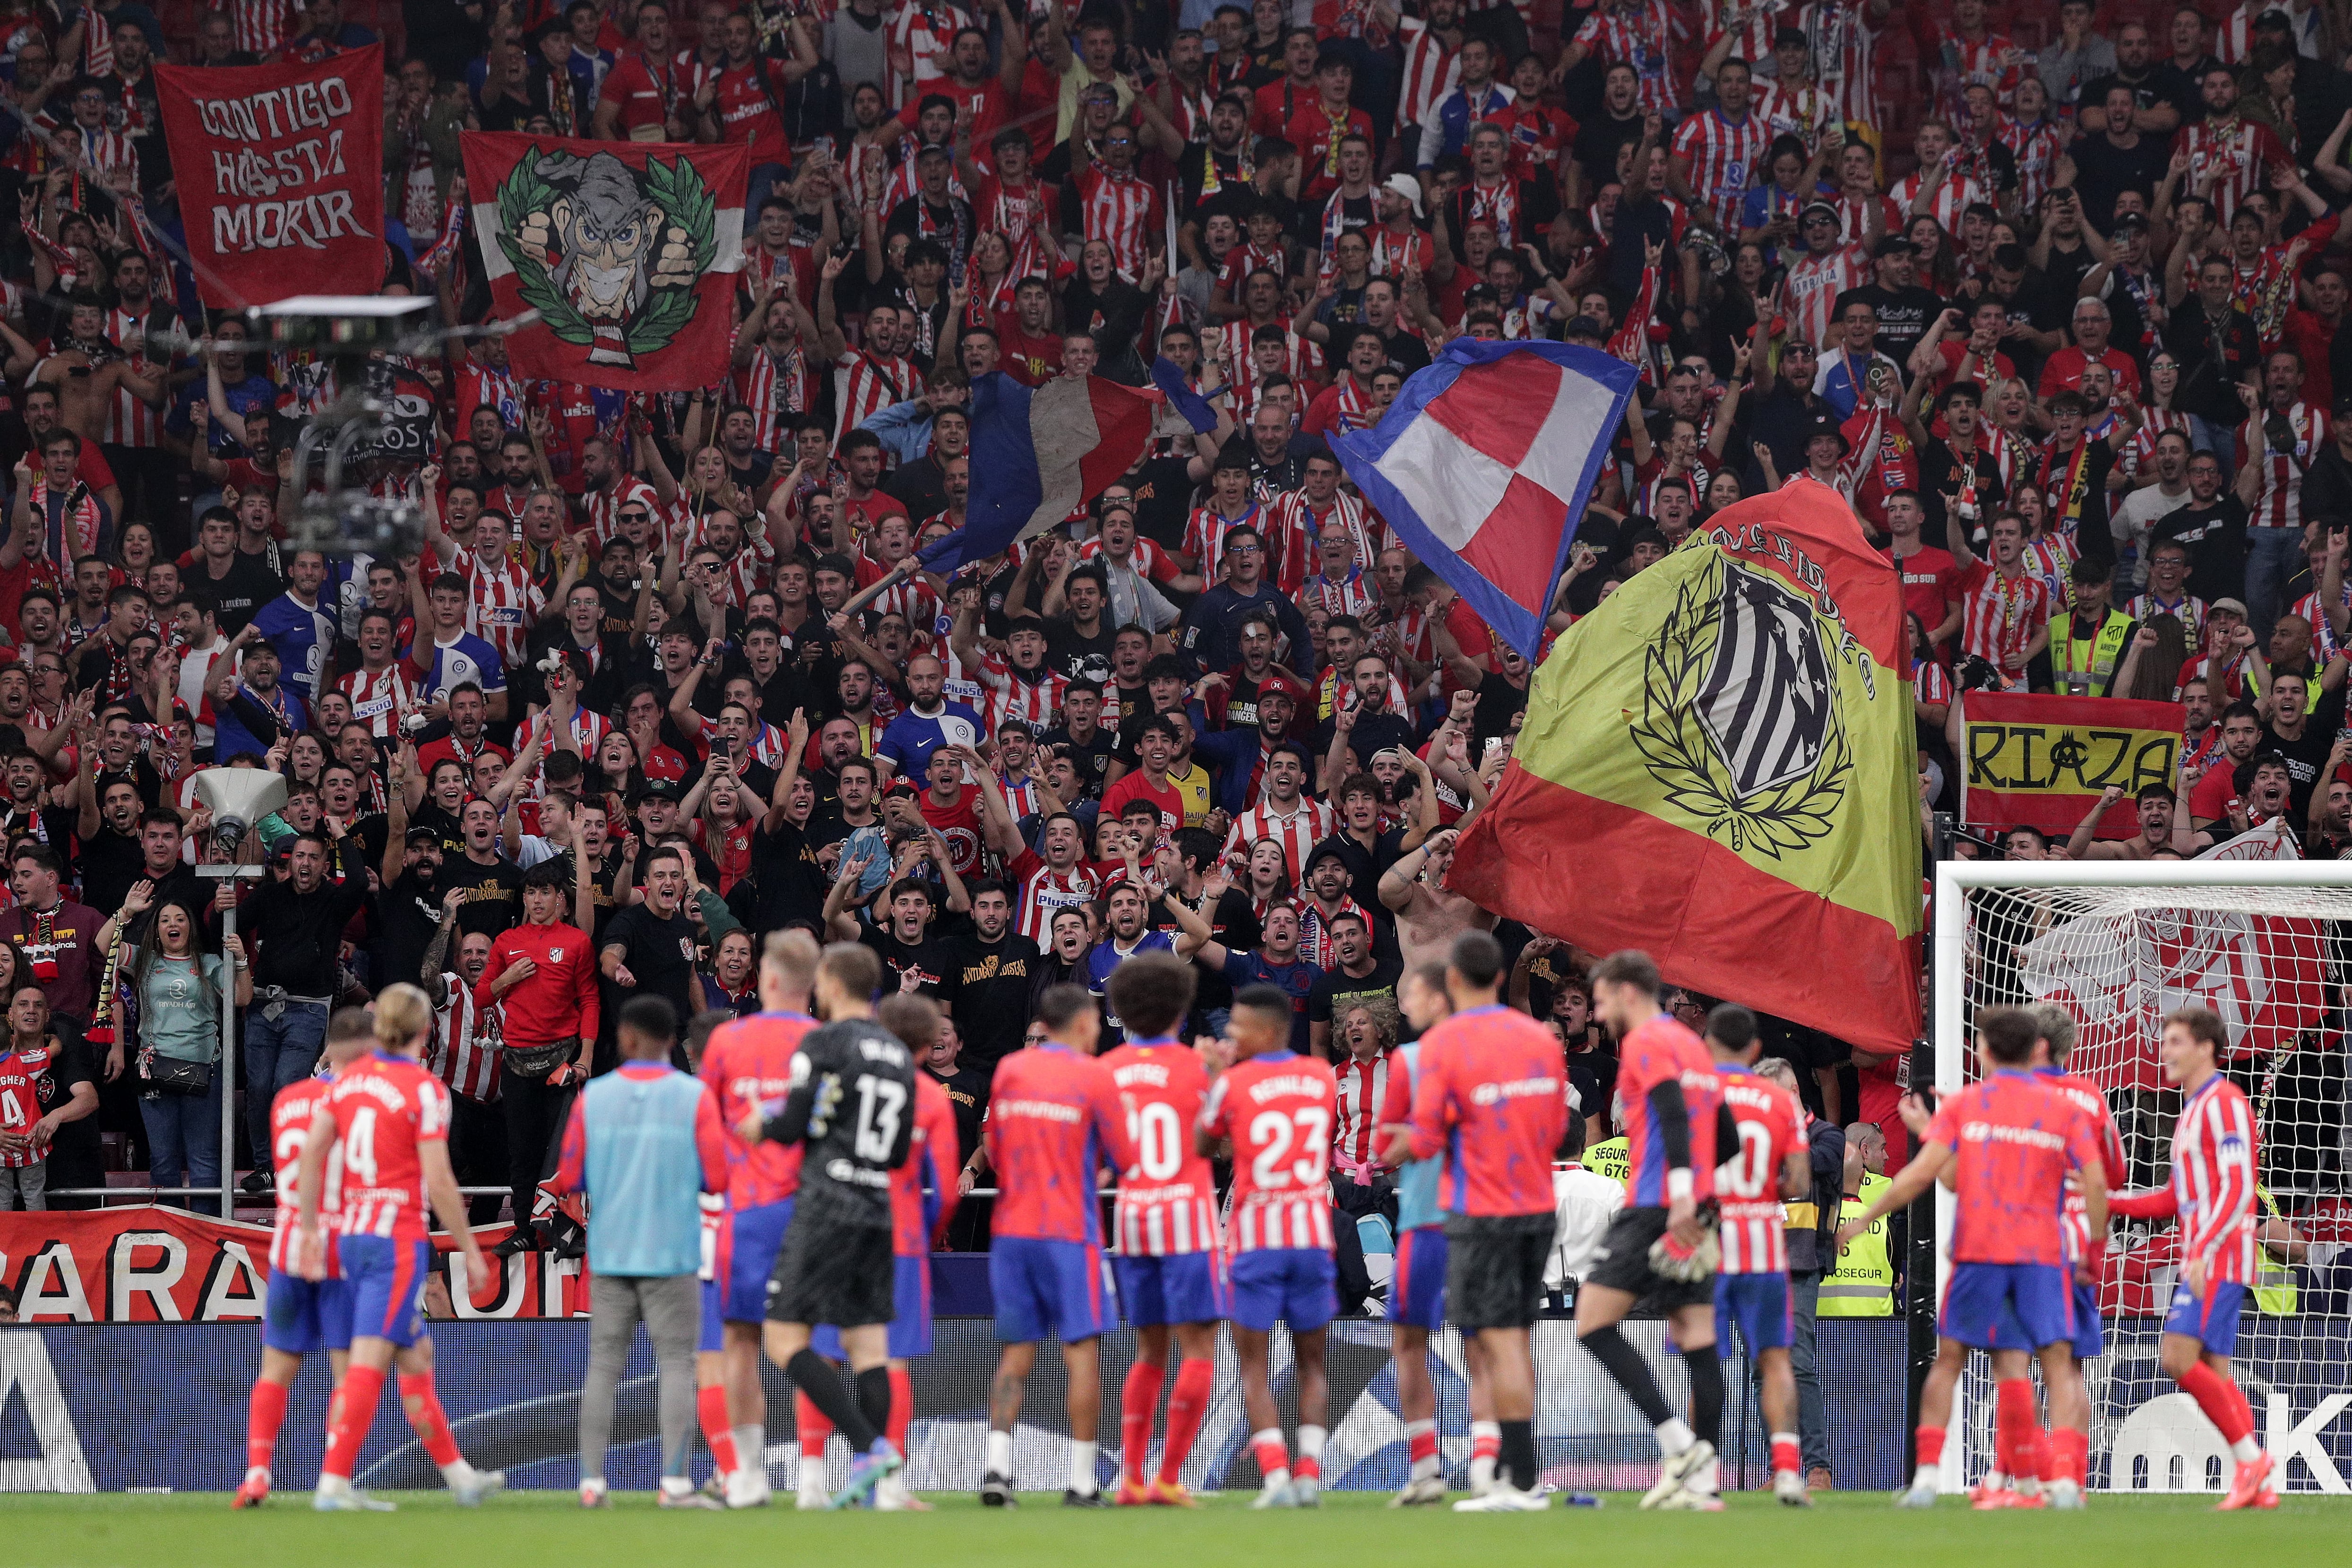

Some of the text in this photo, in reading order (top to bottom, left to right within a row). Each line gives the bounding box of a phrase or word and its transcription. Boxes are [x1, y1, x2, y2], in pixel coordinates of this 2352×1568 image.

[942, 683, 983, 697] Plus50
[1969, 725, 2175, 793] RIAZA
[53, 942, 76, 950] ginals
[0, 1088, 26, 1127] 4
[854, 1074, 908, 1163] 13
[346, 1105, 380, 1187] 4
[1249, 1106, 1330, 1190] 23
[0, 1226, 270, 1322] ARA
[1827, 1268, 1882, 1279] OSEGUR
